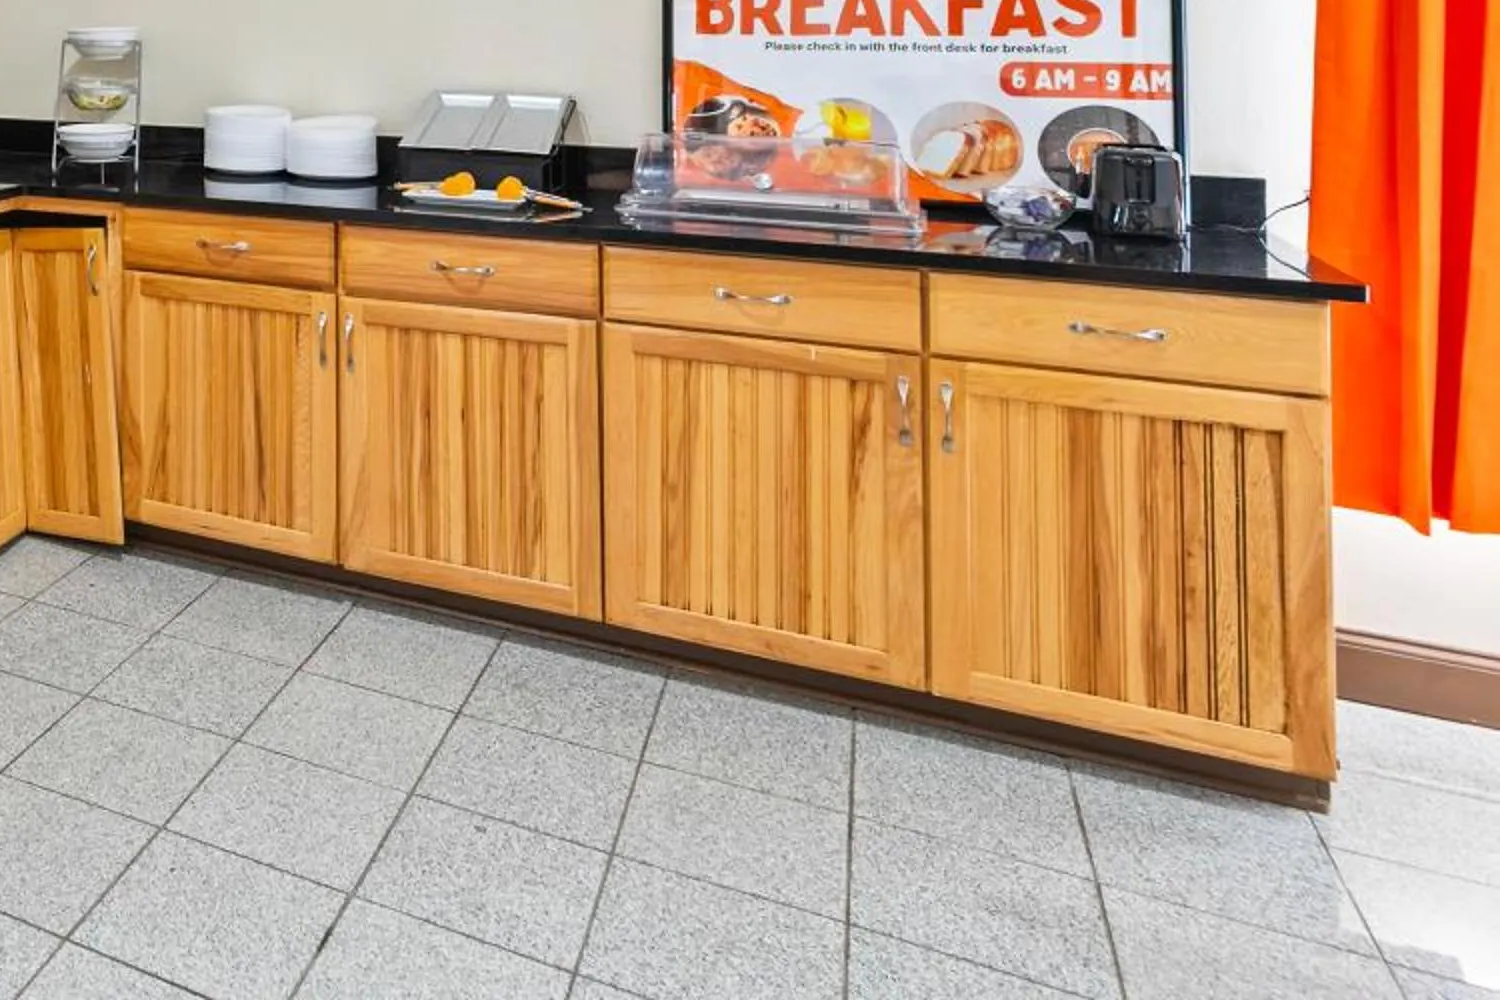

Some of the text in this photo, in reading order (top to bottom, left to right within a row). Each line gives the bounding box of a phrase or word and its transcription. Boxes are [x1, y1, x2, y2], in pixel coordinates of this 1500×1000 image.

[764, 41, 1069, 55] Please check in with the front desk for breakfast
[1010, 68, 1027, 90] 6
[1033, 68, 1076, 91] AM
[1104, 69, 1121, 92] 9
[1129, 70, 1172, 94] AM
